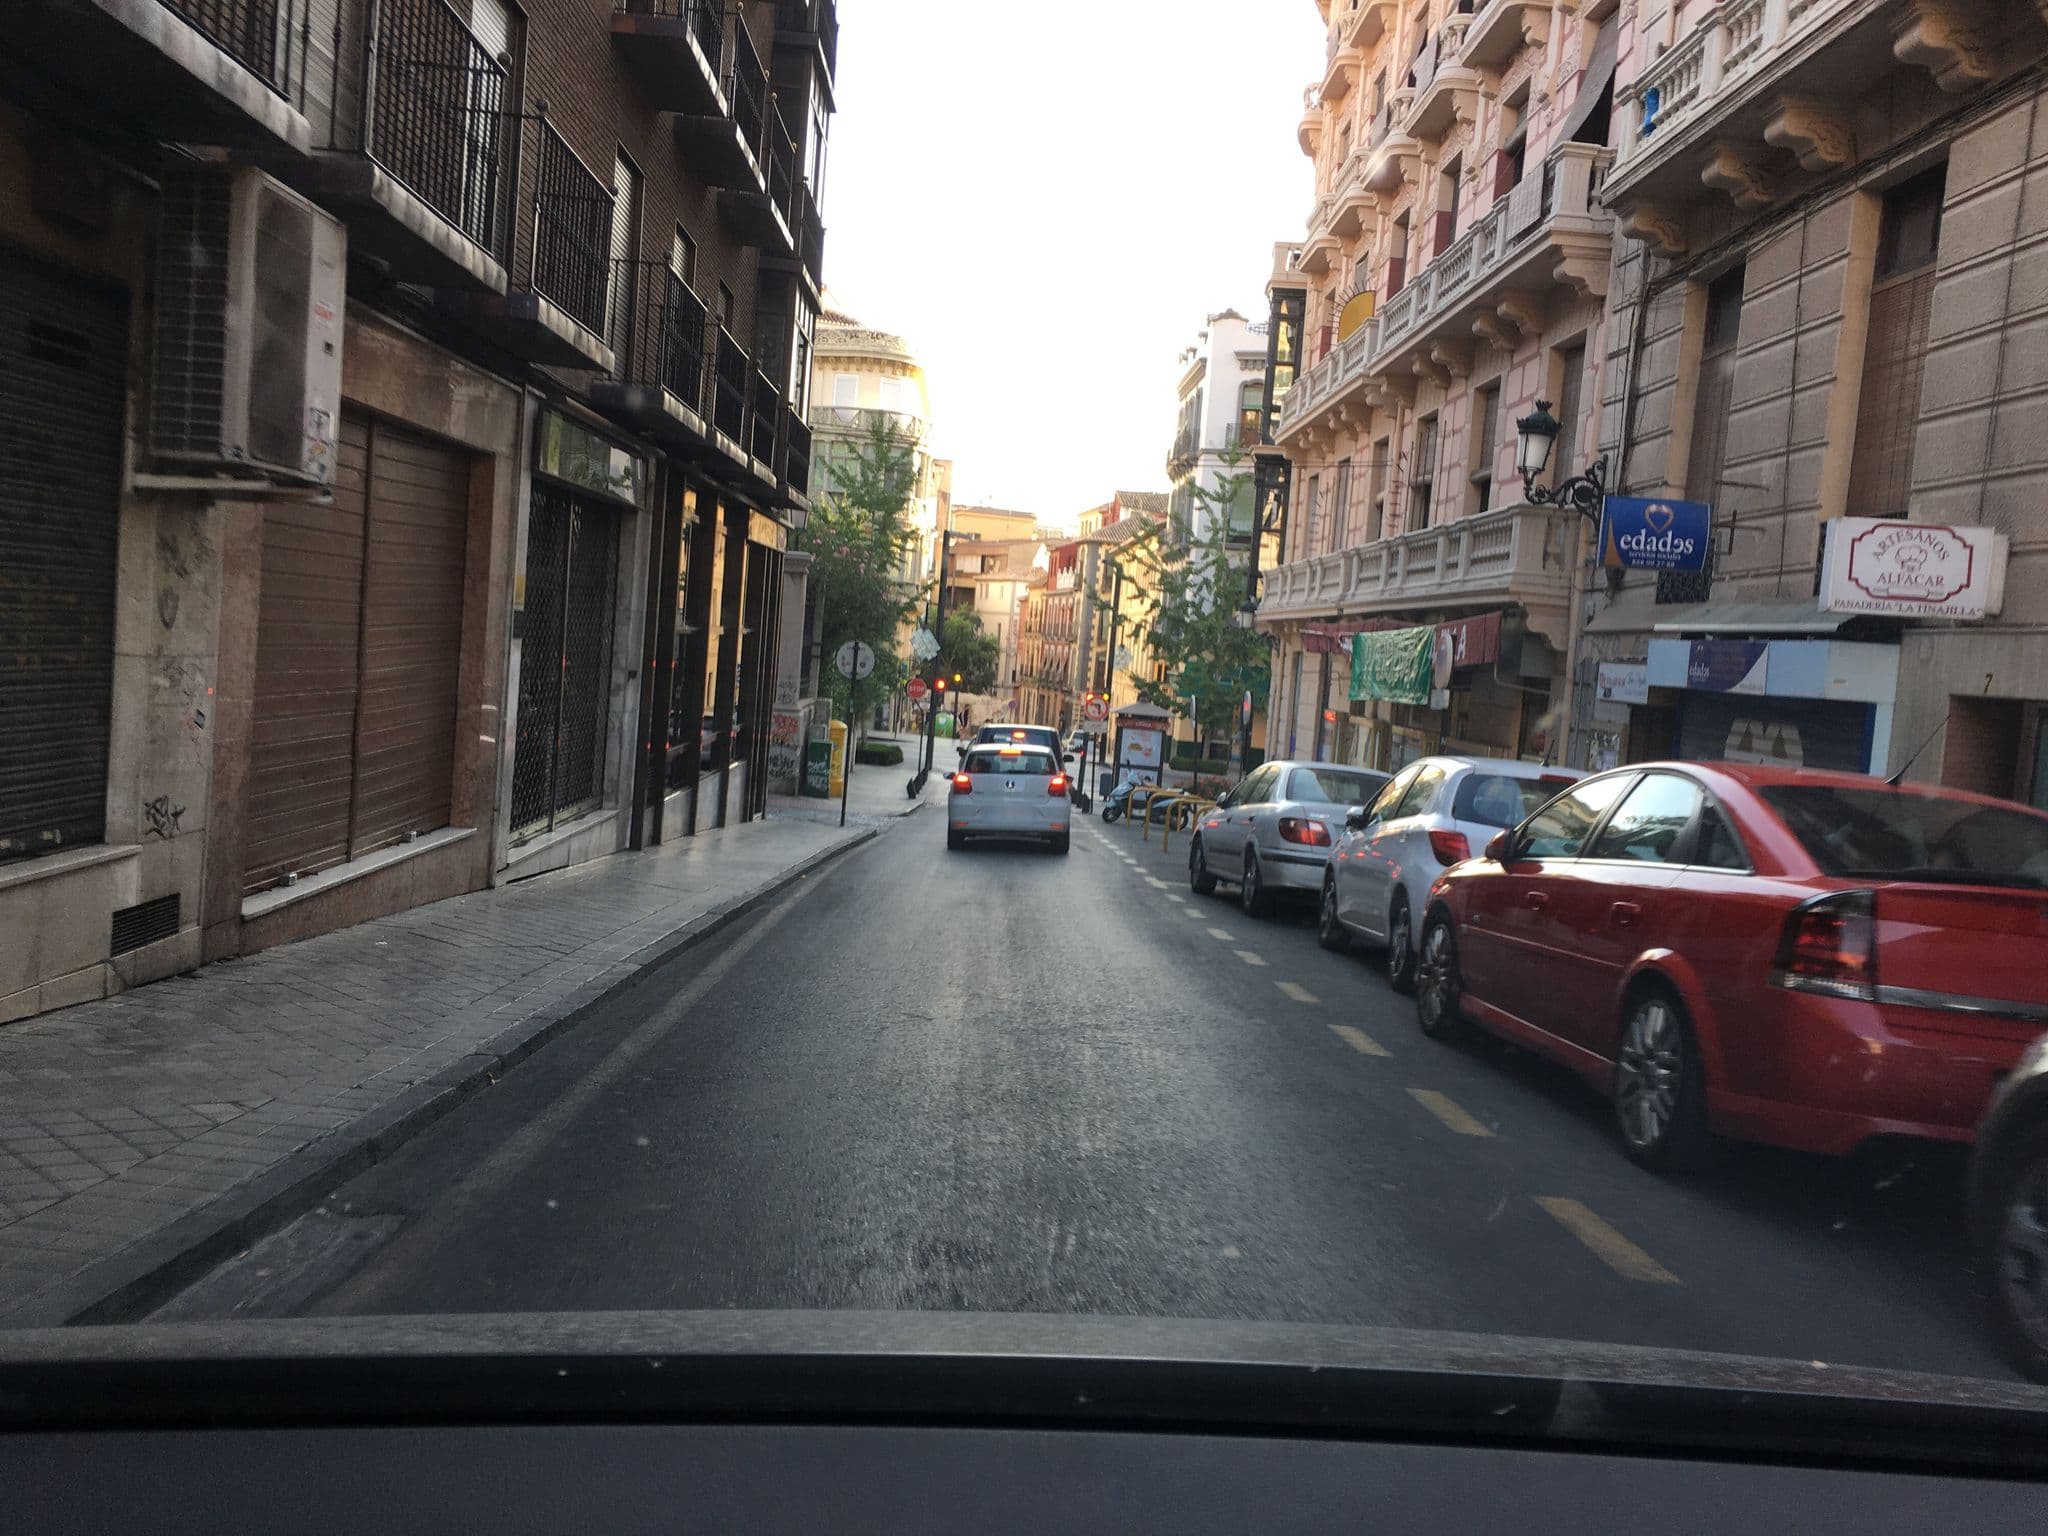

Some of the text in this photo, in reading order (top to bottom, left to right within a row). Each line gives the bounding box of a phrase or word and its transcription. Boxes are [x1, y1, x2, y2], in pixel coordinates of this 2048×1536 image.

[1620, 528, 1694, 554] edados
[1874, 528, 1950, 561] ARTESANOS
[1877, 572, 1945, 587] ALFACAR
[1984, 673, 1994, 695] 7
